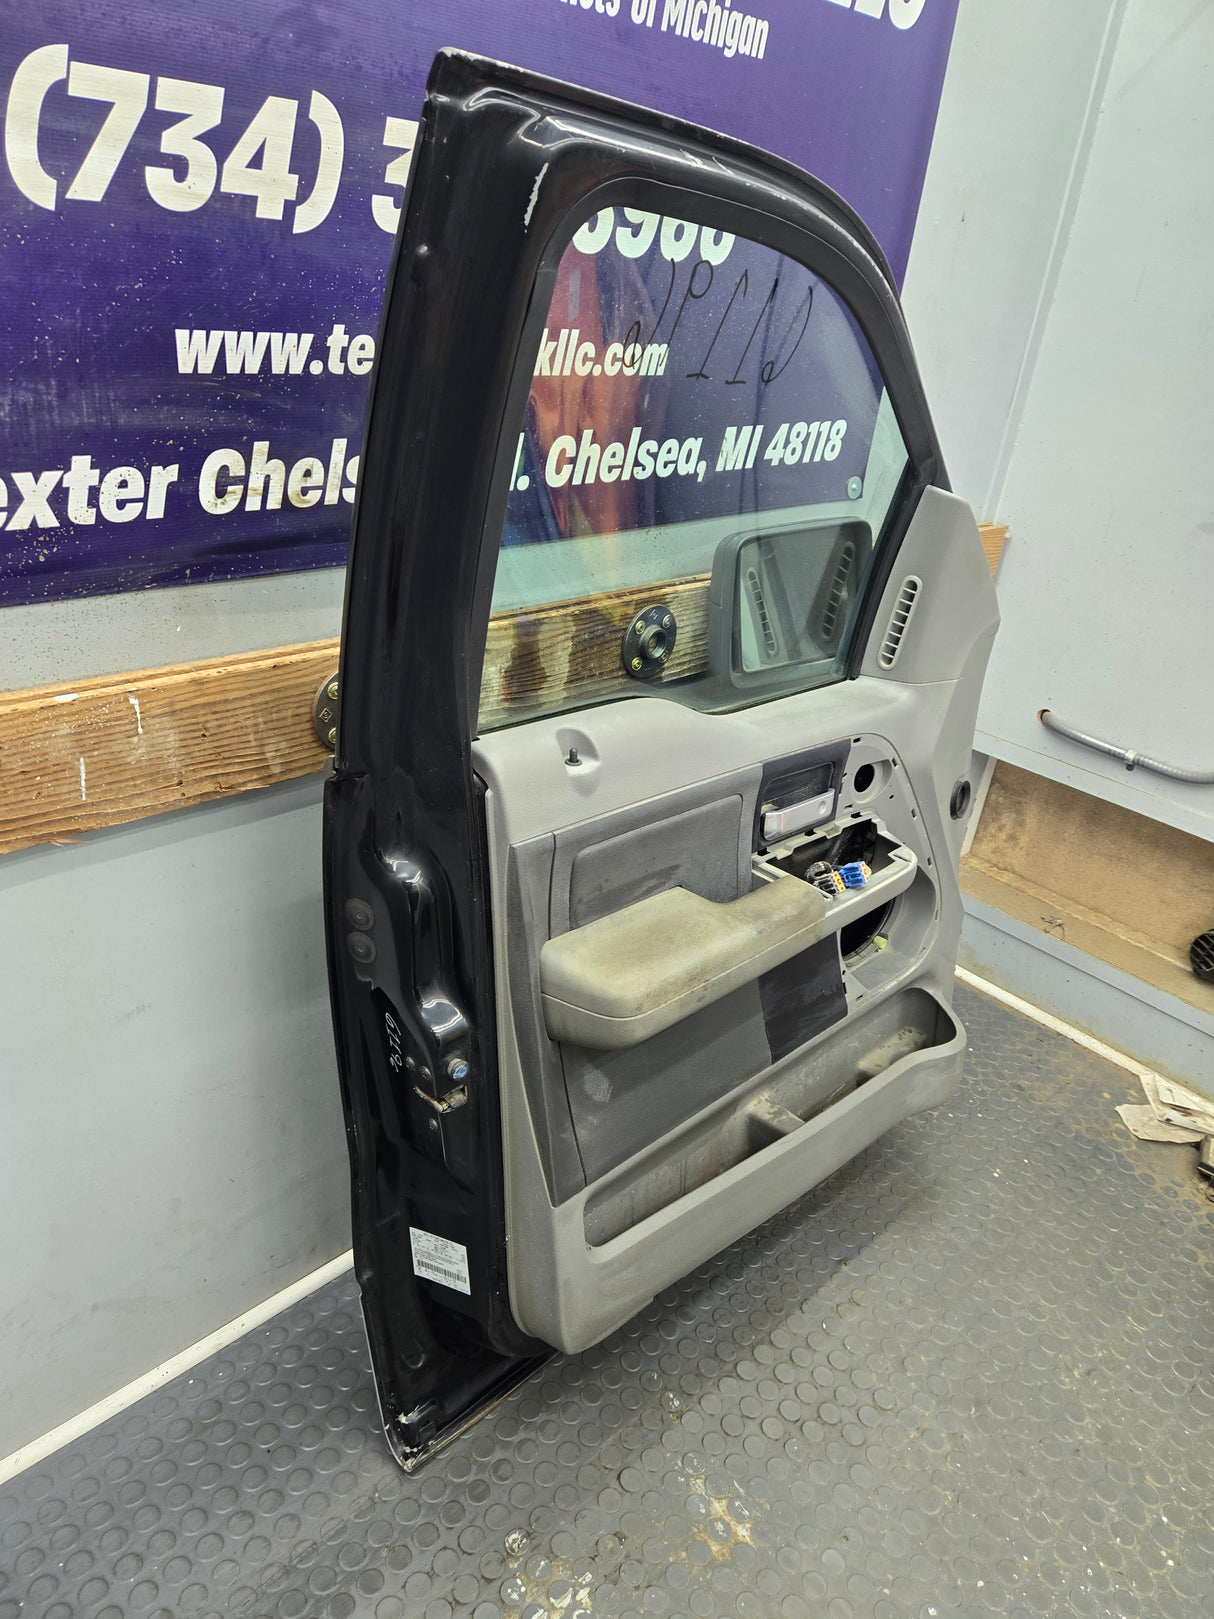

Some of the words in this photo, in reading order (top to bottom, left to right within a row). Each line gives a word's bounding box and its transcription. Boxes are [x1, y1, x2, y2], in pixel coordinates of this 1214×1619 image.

[660, 0, 769, 60] Michigan
[5, 43, 345, 234] (734)
[0, 454, 180, 532] xter
[544, 426, 707, 489] Chelsea,
[715, 424, 765, 472] MI
[763, 419, 848, 467] 48118
